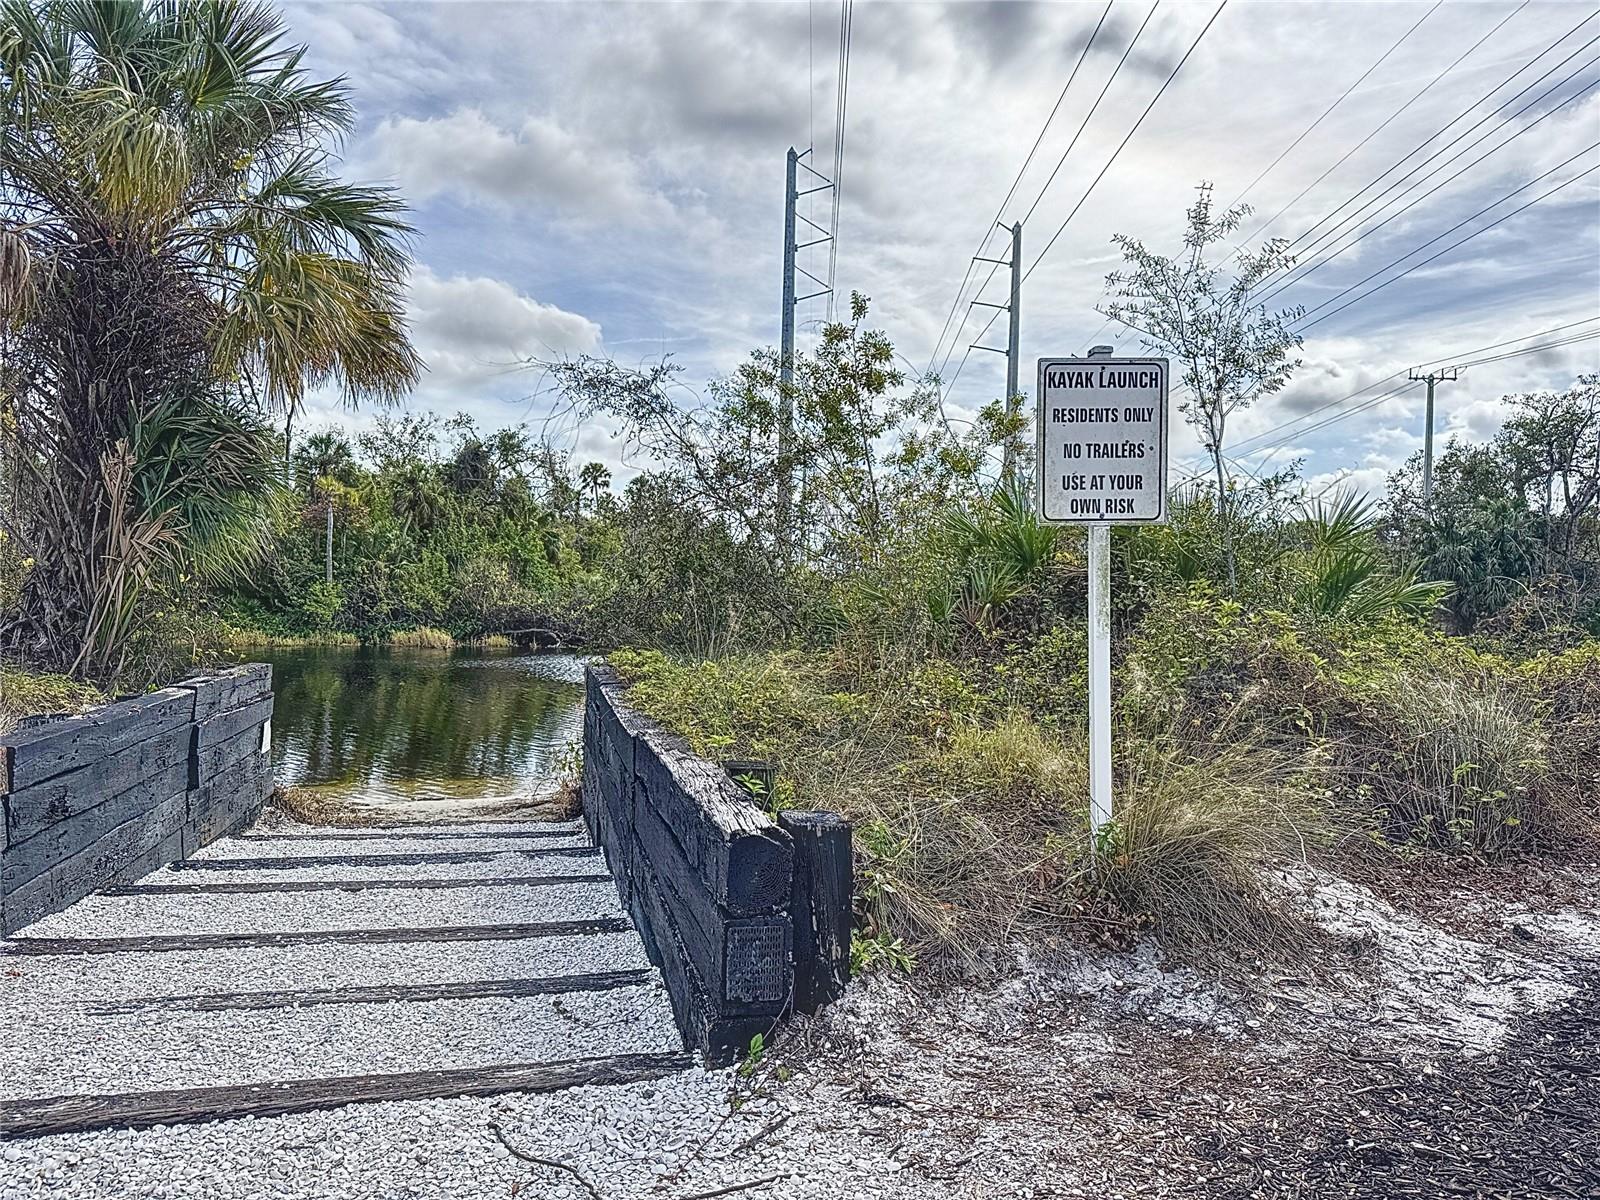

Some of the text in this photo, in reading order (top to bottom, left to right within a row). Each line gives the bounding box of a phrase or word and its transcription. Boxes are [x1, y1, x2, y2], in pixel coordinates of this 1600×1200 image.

[1048, 371, 1159, 389] KAYAK LAUNCH
[1052, 407, 1154, 423] RESIDENTS ONLY
[1063, 443, 1145, 459] NO TRAILERS
[1062, 475, 1143, 490] USE AT YOUR
[1070, 498, 1135, 514] OWN RISK
